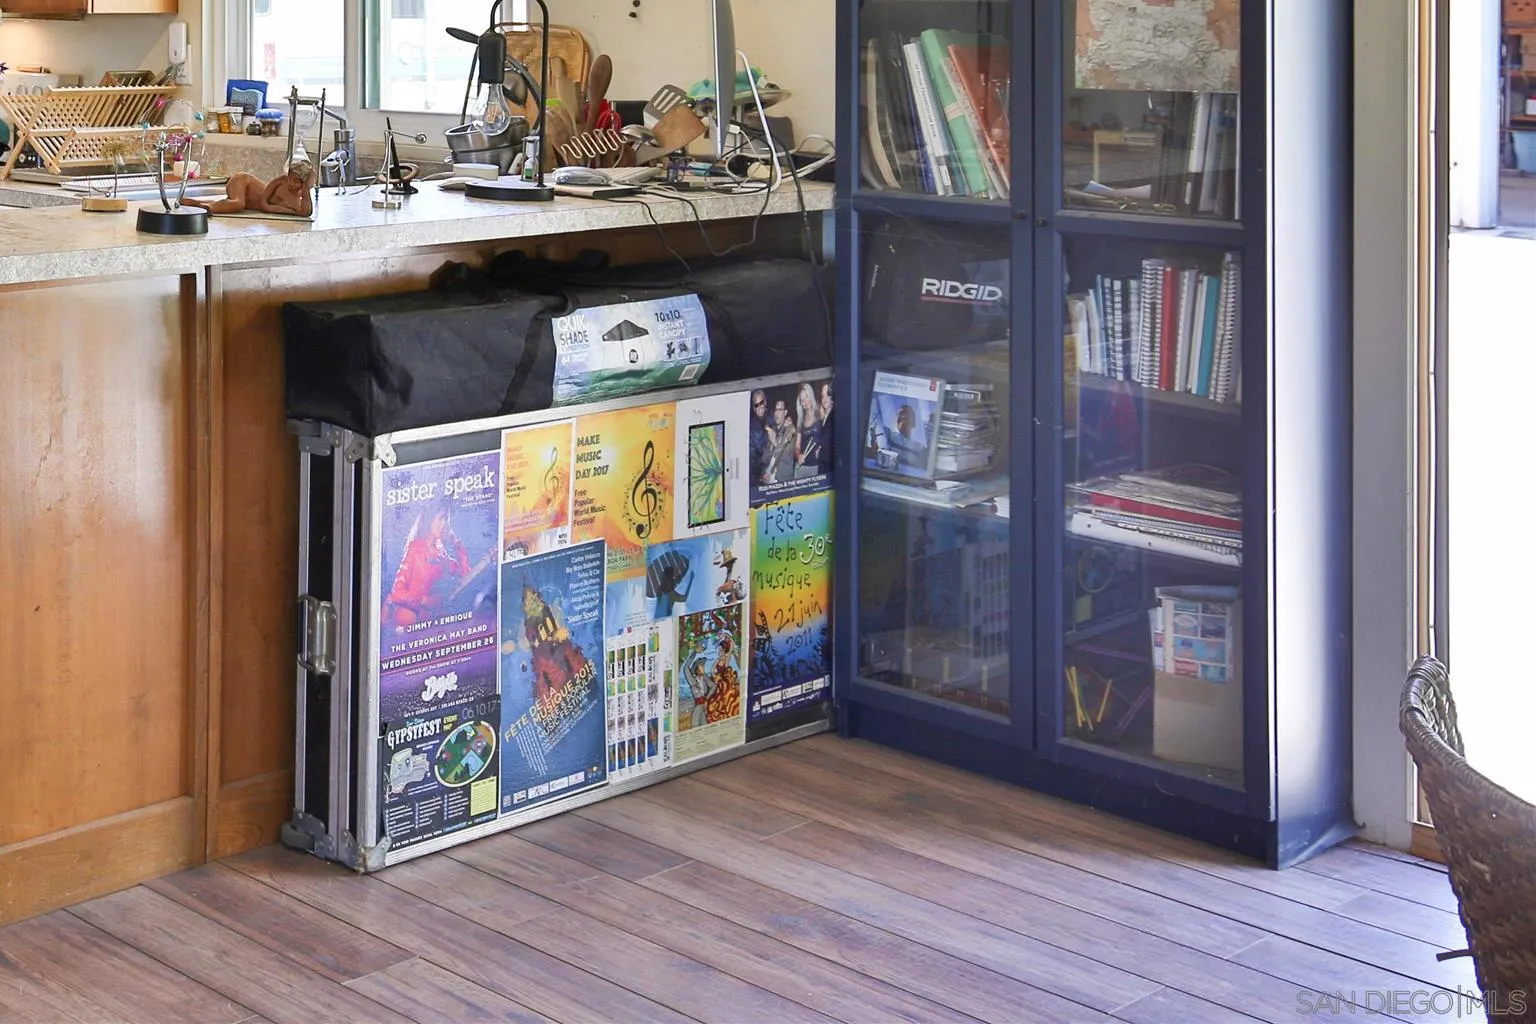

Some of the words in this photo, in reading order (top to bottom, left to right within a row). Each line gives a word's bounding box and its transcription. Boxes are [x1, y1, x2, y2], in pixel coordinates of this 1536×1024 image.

[921, 277, 1004, 301] RIDGID
[558, 314, 585, 332] QUIK
[559, 330, 589, 346] SHADE
[577, 435, 600, 448] MAKE
[576, 449, 602, 464] MUSIC
[386, 480, 438, 507] sister
[444, 464, 496, 500] speak
[575, 467, 591, 480] DAY
[574, 498, 595, 507] Popular
[574, 507, 590, 517] World
[590, 505, 606, 514] Music
[573, 516, 596, 527] Festival
[764, 502, 803, 535] Fête
[767, 536, 783, 561] de
[785, 539, 797, 562] la
[752, 567, 812, 598] musique
[406, 621, 432, 633] JIMMY
[440, 611, 473, 625] ENRIQUE
[582, 609, 599, 620] Speak
[773, 601, 795, 633] 21
[797, 593, 822, 628] juin
[391, 644, 406, 653] THE
[408, 634, 448, 649] VERONICA
[449, 629, 465, 640] MAY
[467, 624, 487, 635] BAND
[785, 628, 813, 655] 2011
[381, 651, 433, 670] WEDNESDAY
[435, 640, 482, 658] SEPTEMBER
[529, 698, 543, 718] DE
[543, 687, 557, 703] LA
[532, 679, 574, 727] MUSIQUE
[542, 705, 561, 727] FREE
[566, 667, 598, 703] POPULAR
[537, 717, 560, 741] MUSIC
[559, 687, 591, 720] FESTIVAL
[387, 718, 442, 751] GYPSYFEST
